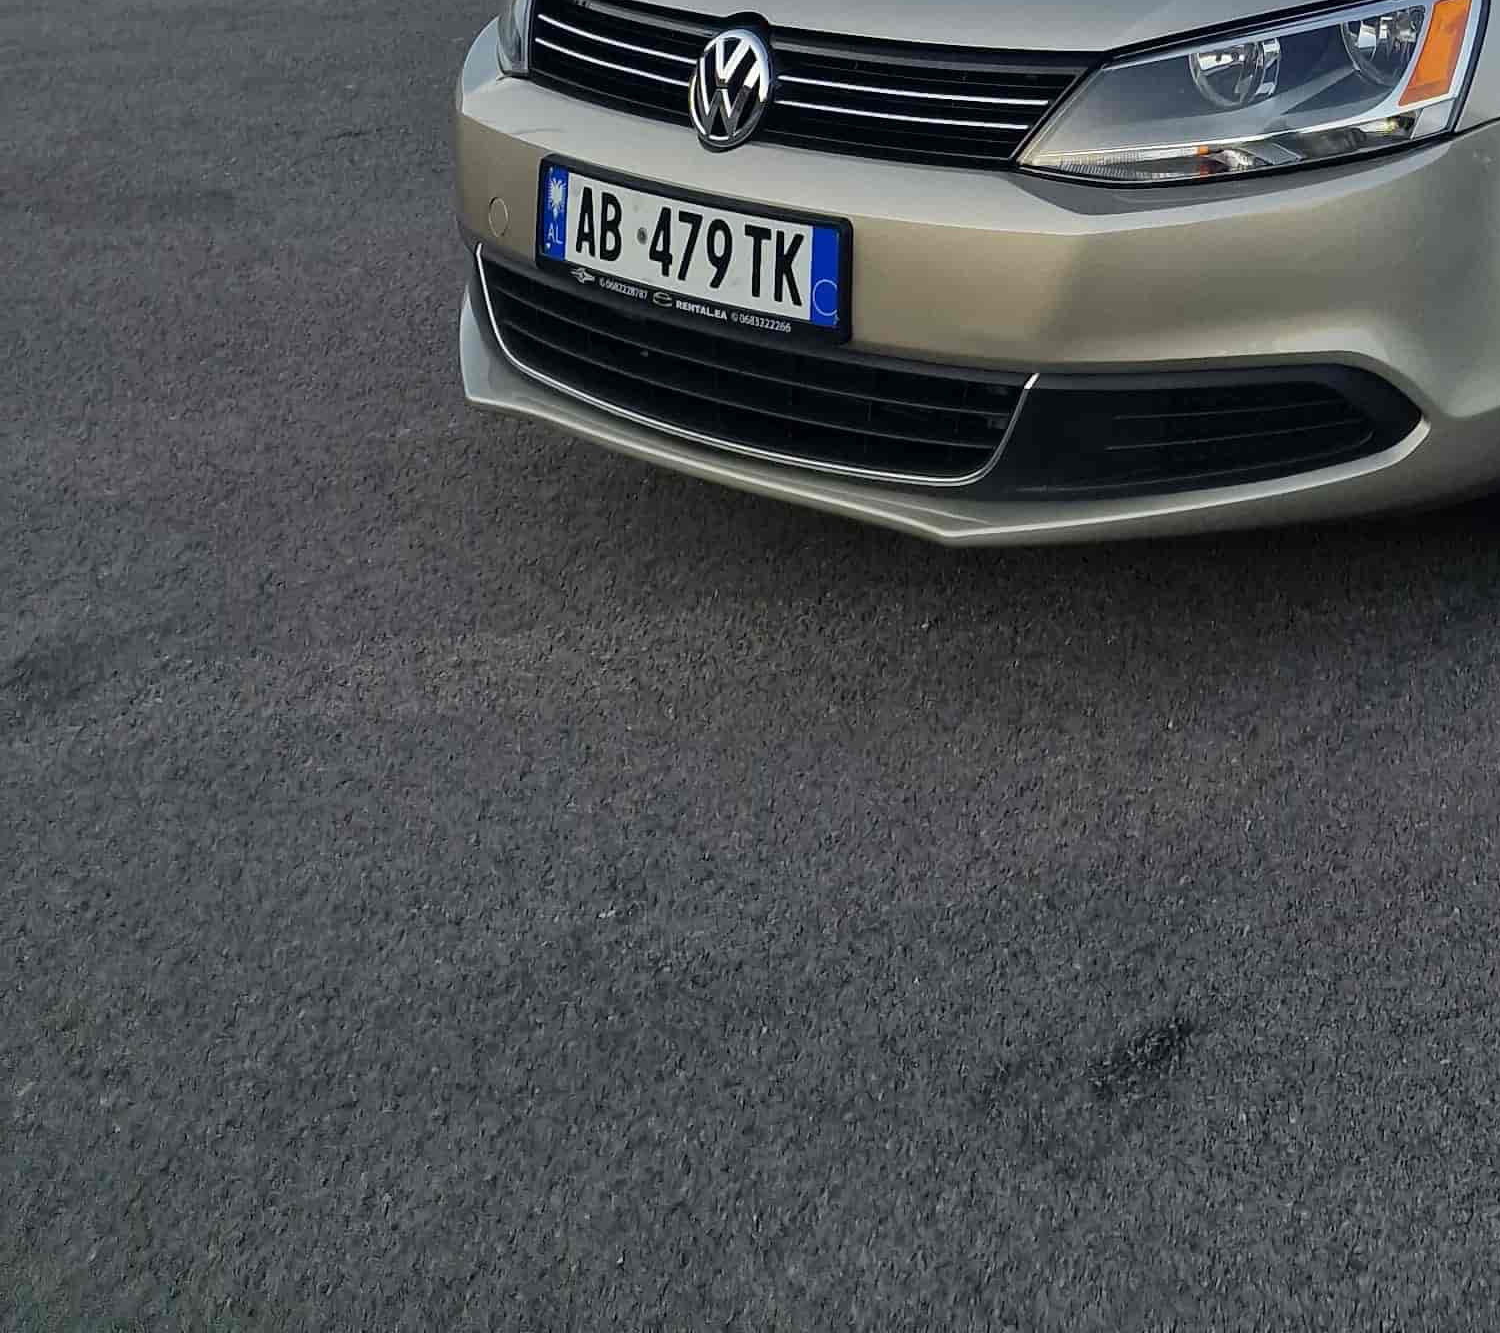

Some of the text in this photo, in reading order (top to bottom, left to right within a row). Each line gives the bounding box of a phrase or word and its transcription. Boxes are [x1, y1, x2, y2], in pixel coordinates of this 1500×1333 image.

[547, 223, 563, 244] AL
[576, 186, 804, 307] AB 479 TK
